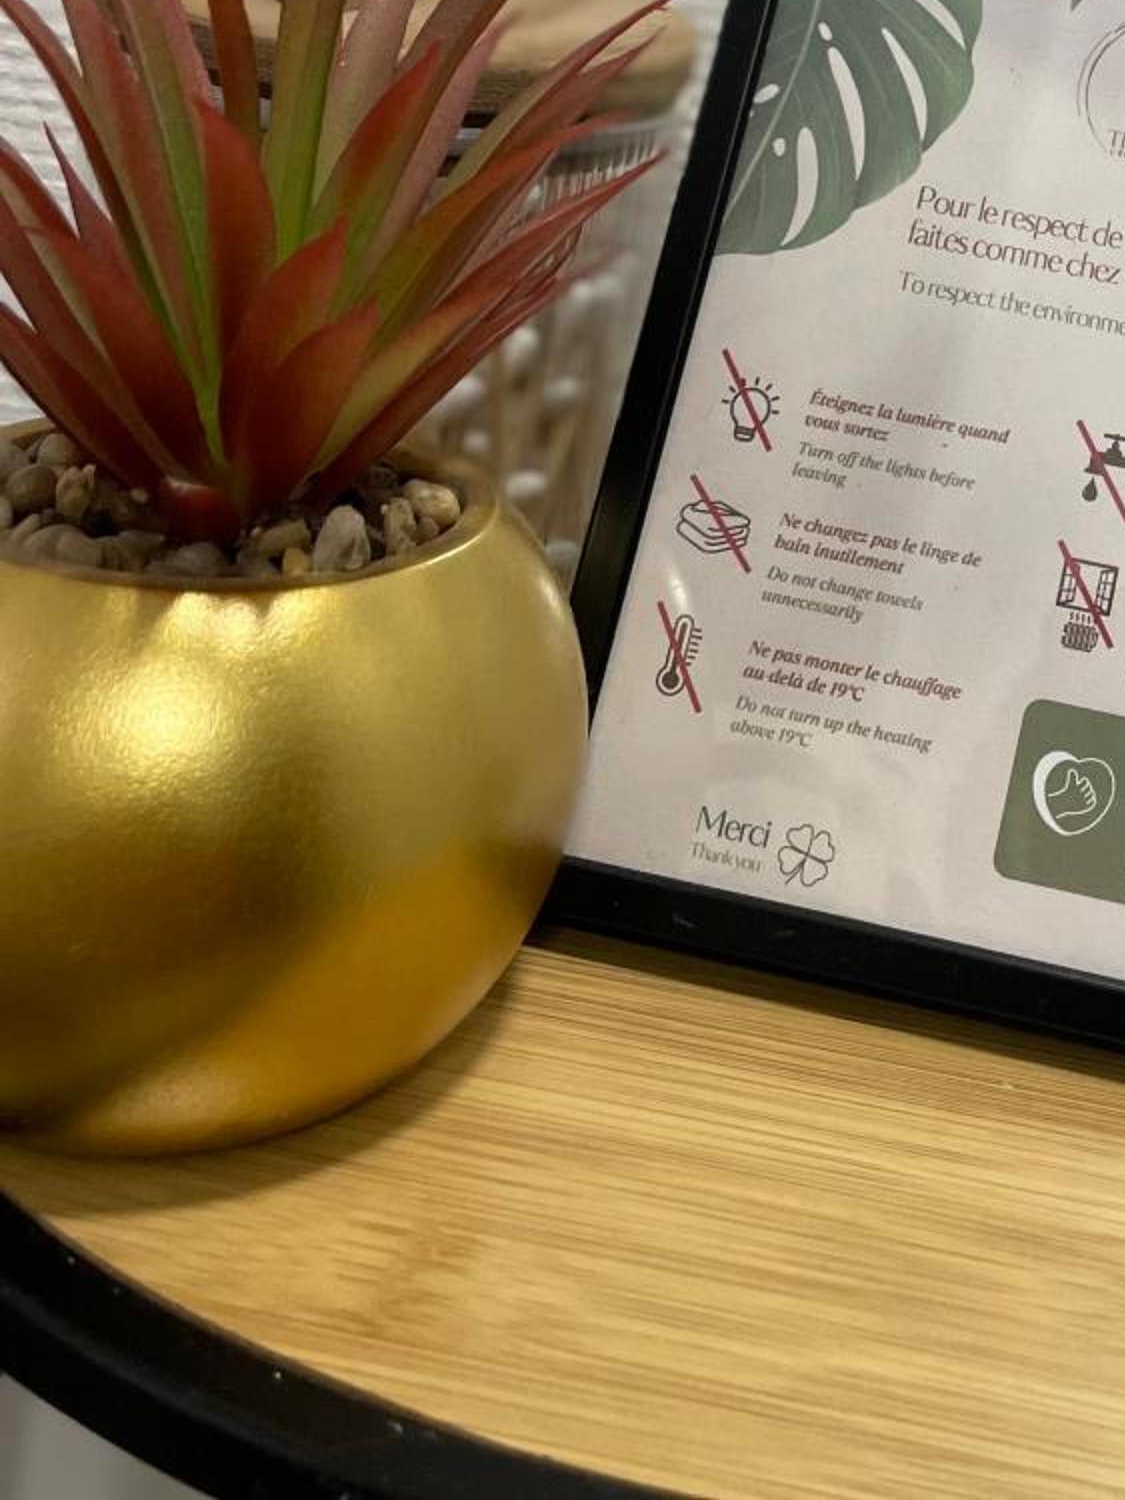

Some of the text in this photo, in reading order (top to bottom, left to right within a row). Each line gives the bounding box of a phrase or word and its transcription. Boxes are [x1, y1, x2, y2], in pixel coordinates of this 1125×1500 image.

[916, 185, 975, 218] Pour
[977, 195, 998, 224] le
[1000, 209, 1088, 242] respect
[1091, 220, 1123, 249] de
[907, 218, 968, 255] faites
[971, 239, 1063, 273] comme
[1064, 251, 1121, 284] chez
[899, 269, 925, 294] To
[926, 282, 994, 308] respect
[999, 291, 1031, 315] the
[804, 414, 890, 442] vous sortez
[808, 387, 1011, 444] Éteignez la lumière quand
[791, 461, 847, 488] leaving
[798, 440, 975, 490] Turn off the lights before
[773, 533, 904, 574] bain inutilement
[779, 512, 982, 567] Ne changez pas le linge de
[760, 590, 864, 624] unnecessarily
[766, 564, 923, 611] Do not change towels
[748, 639, 962, 700] Ne pas monter le chauffage
[805, 676, 827, 694] de
[828, 681, 865, 702] 19°C
[729, 718, 812, 747] above 19°C
[735, 694, 933, 754] Do not turn up the heating
[695, 805, 772, 848] Merci
[691, 841, 761, 872] Thank you
